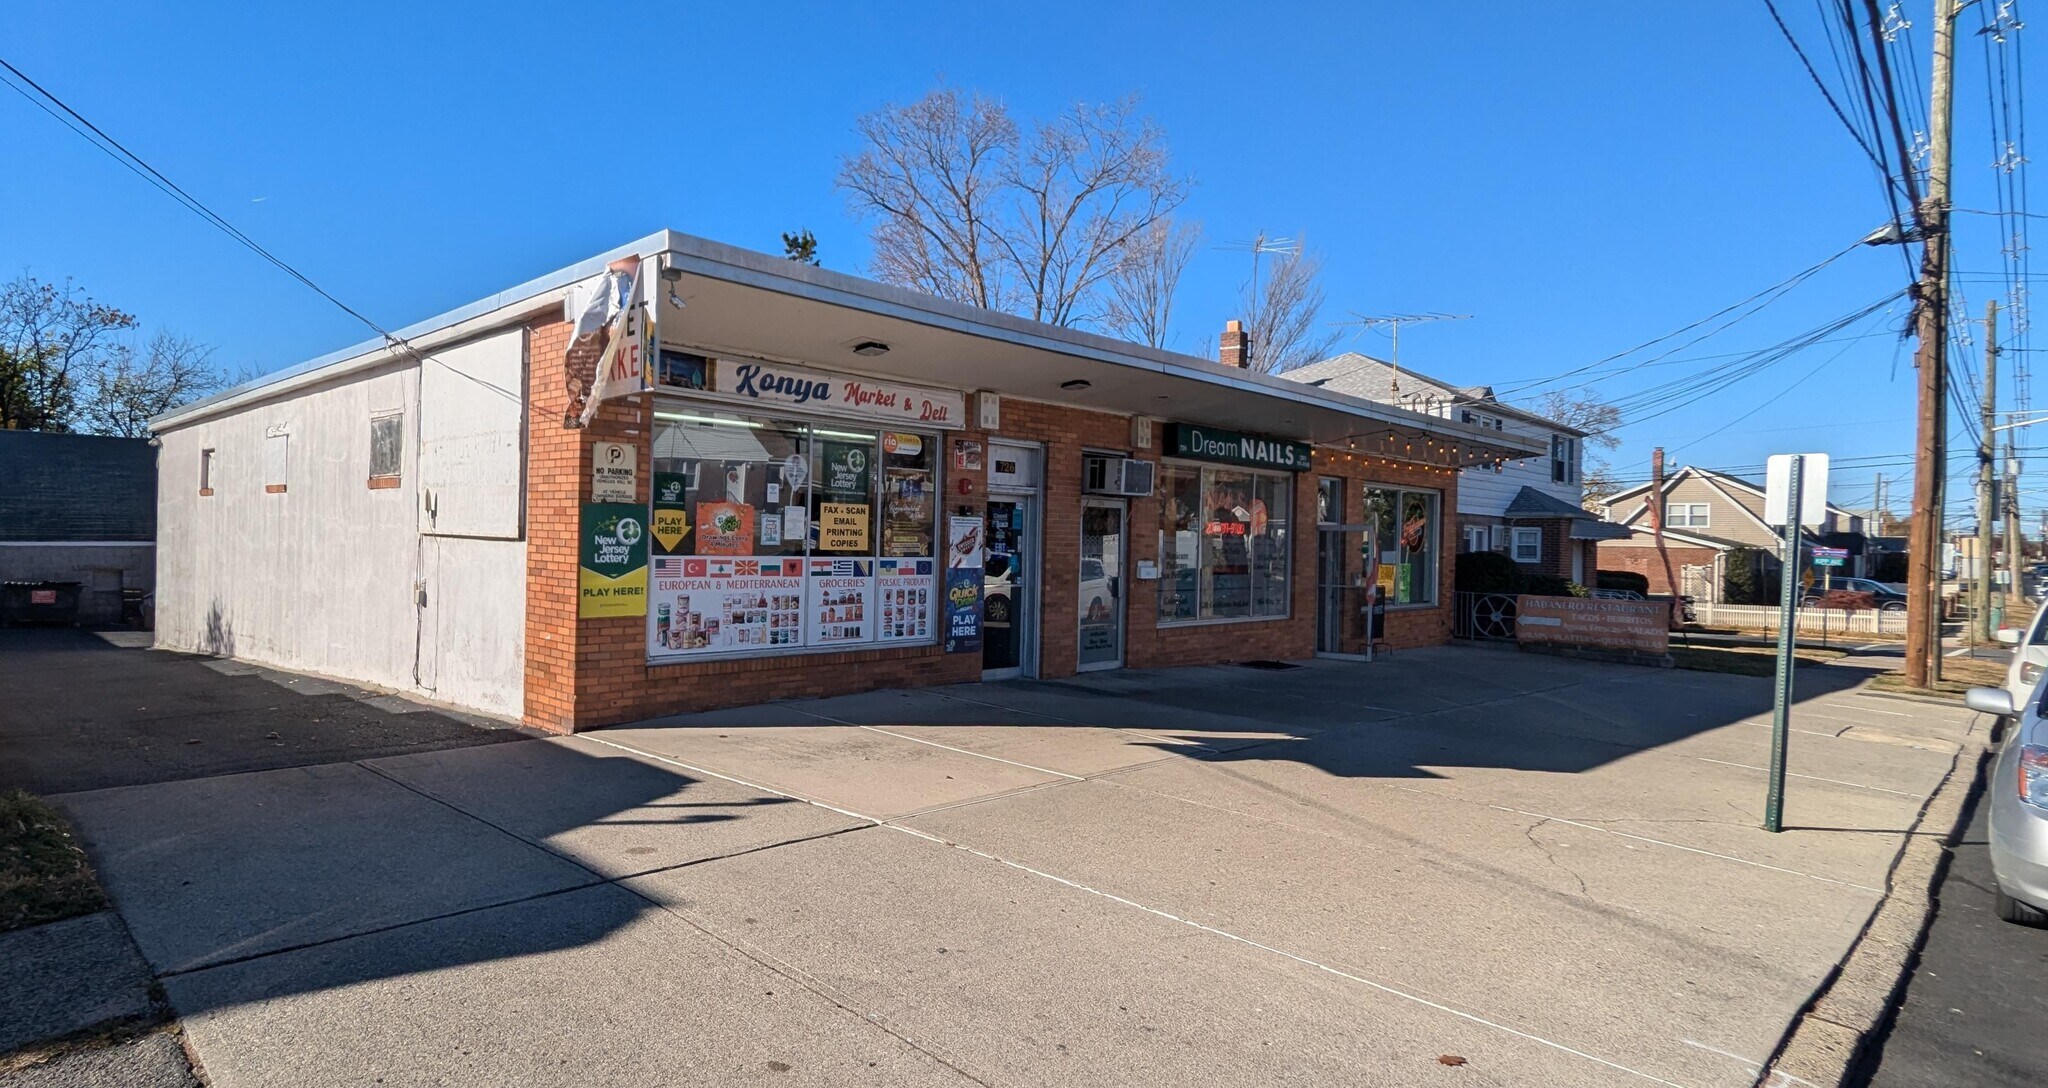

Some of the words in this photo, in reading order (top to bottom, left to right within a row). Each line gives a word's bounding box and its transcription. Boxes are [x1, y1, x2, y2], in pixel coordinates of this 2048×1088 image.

[735, 364, 832, 403] Konya
[843, 381, 896, 407] Market
[903, 397, 913, 411] &
[884, 435, 897, 446] ria
[1192, 430, 1238, 457] Dream
[1241, 437, 1294, 465] NAILS
[607, 468, 633, 476] PARKING
[831, 462, 848, 472] New
[999, 461, 1015, 473] 726
[835, 472, 858, 482] Jersey
[831, 478, 857, 490] Lottery
[824, 506, 839, 514] FAX
[846, 507, 866, 515] SCAN
[658, 517, 682, 526] PLAY
[834, 518, 857, 526] EMAIL
[657, 526, 683, 535] HERE
[594, 535, 618, 545] New
[599, 545, 630, 556] Jersey
[594, 553, 629, 564] Lottery
[659, 580, 711, 590] EUROPEAN
[715, 580, 722, 590] &
[726, 579, 800, 590] MEDITERRANEAN
[819, 579, 865, 588] GROCERIES
[879, 578, 901, 587] POLSKIE
[903, 577, 931, 587] PRODUKTY
[583, 588, 610, 597] PLAY
[613, 587, 644, 596] HERE!
[1525, 600, 1584, 613] HABANERO
[1587, 603, 1660, 615] RESTAURANT
[952, 615, 976, 626] PLAY
[1571, 613, 1600, 622] TACOS
[1606, 615, 1653, 625] BURRITOS
[952, 626, 977, 637] HERE
[1628, 627, 1665, 636] SALADS
[1601, 637, 1664, 648] QUESADILLAS
